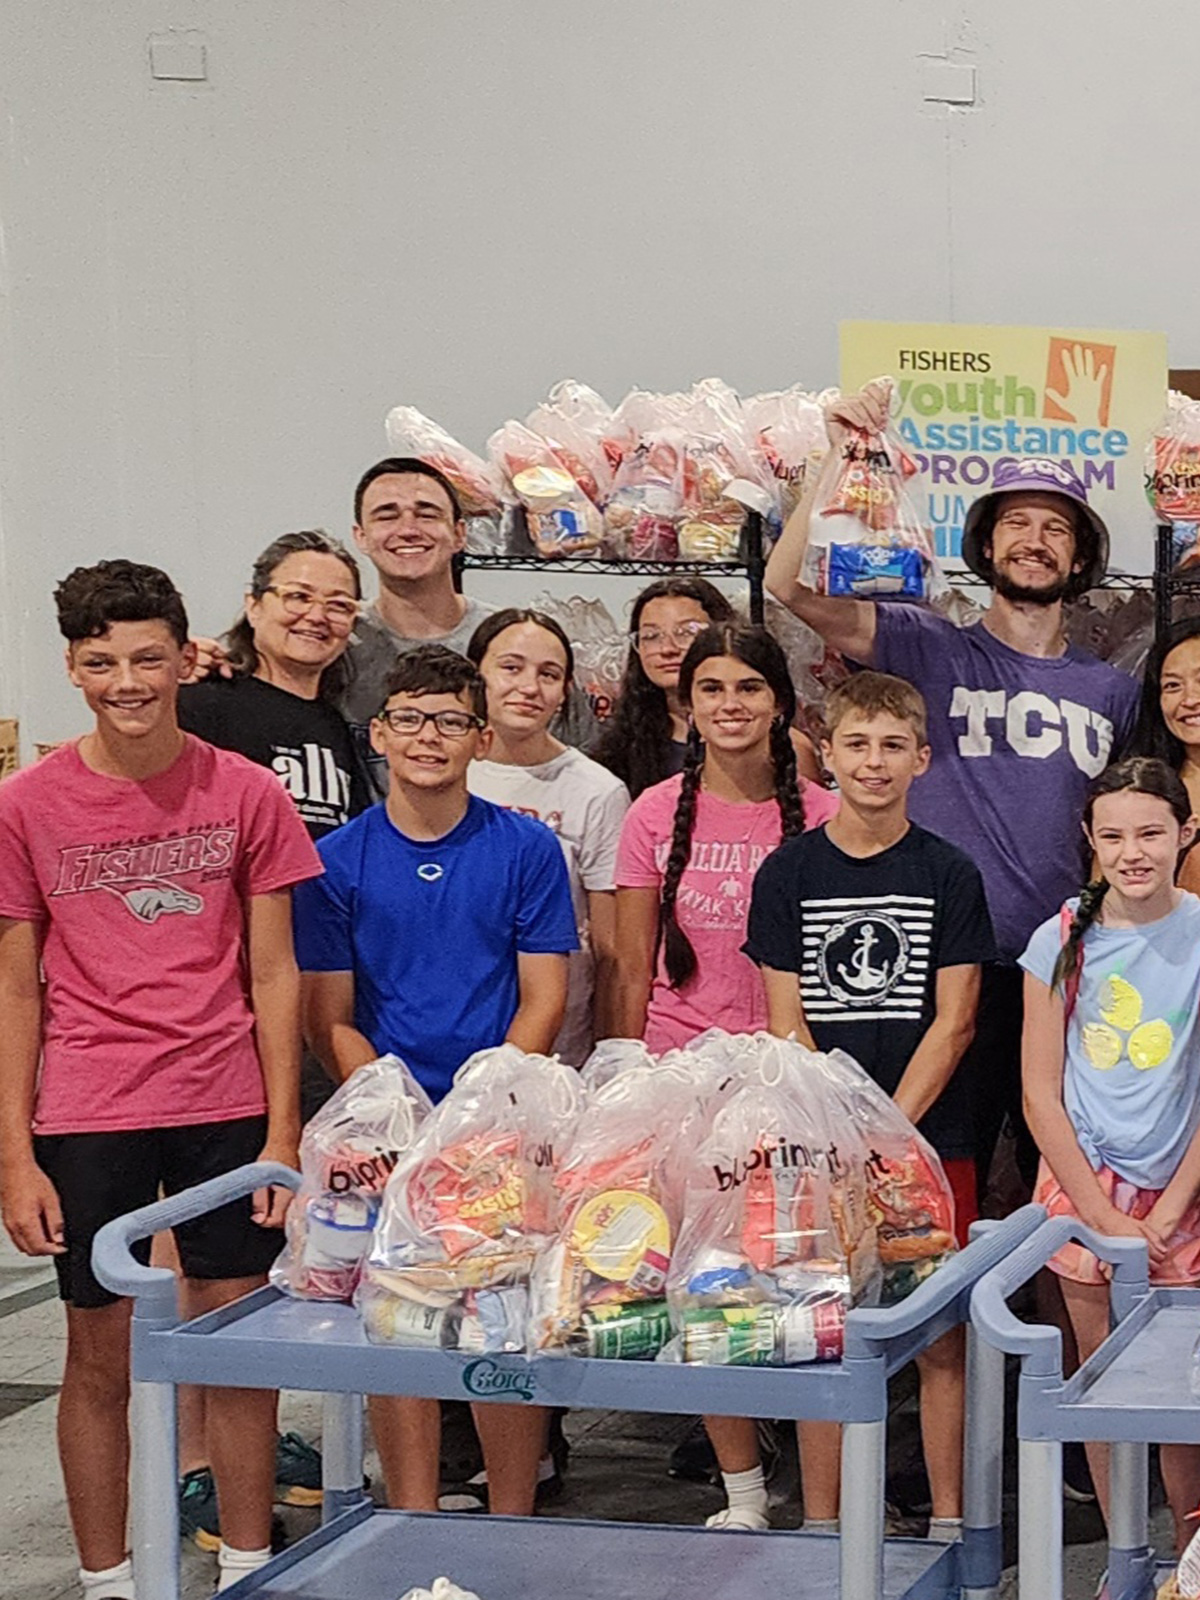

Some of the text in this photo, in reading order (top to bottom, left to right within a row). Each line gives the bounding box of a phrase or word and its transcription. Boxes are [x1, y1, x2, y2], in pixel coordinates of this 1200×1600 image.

[899, 350, 991, 373] FISHERS
[899, 415, 1129, 456] Assistance
[948, 686, 1114, 779] TCU
[49, 828, 237, 897] FISHERS
[654, 841, 743, 874] WILUA
